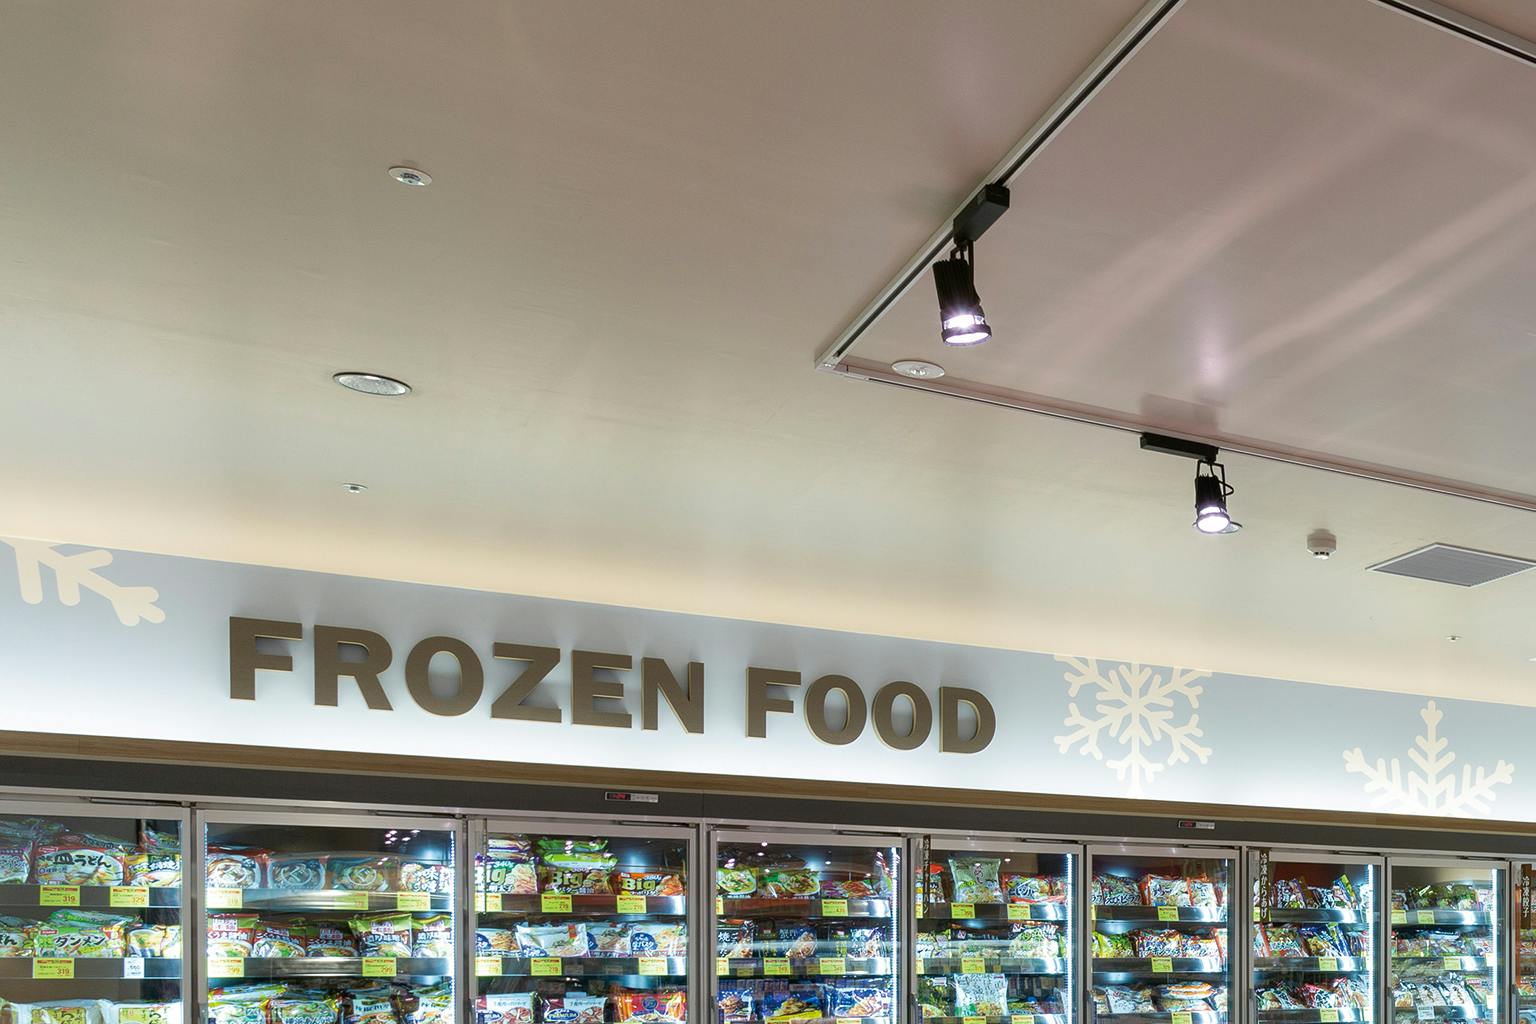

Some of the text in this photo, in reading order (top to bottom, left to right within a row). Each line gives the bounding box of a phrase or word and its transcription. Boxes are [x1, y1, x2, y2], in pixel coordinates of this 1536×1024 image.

[229, 616, 997, 754] FROZEN FOOD
[551, 869, 584, 888] Big
[621, 876, 656, 890] Big
